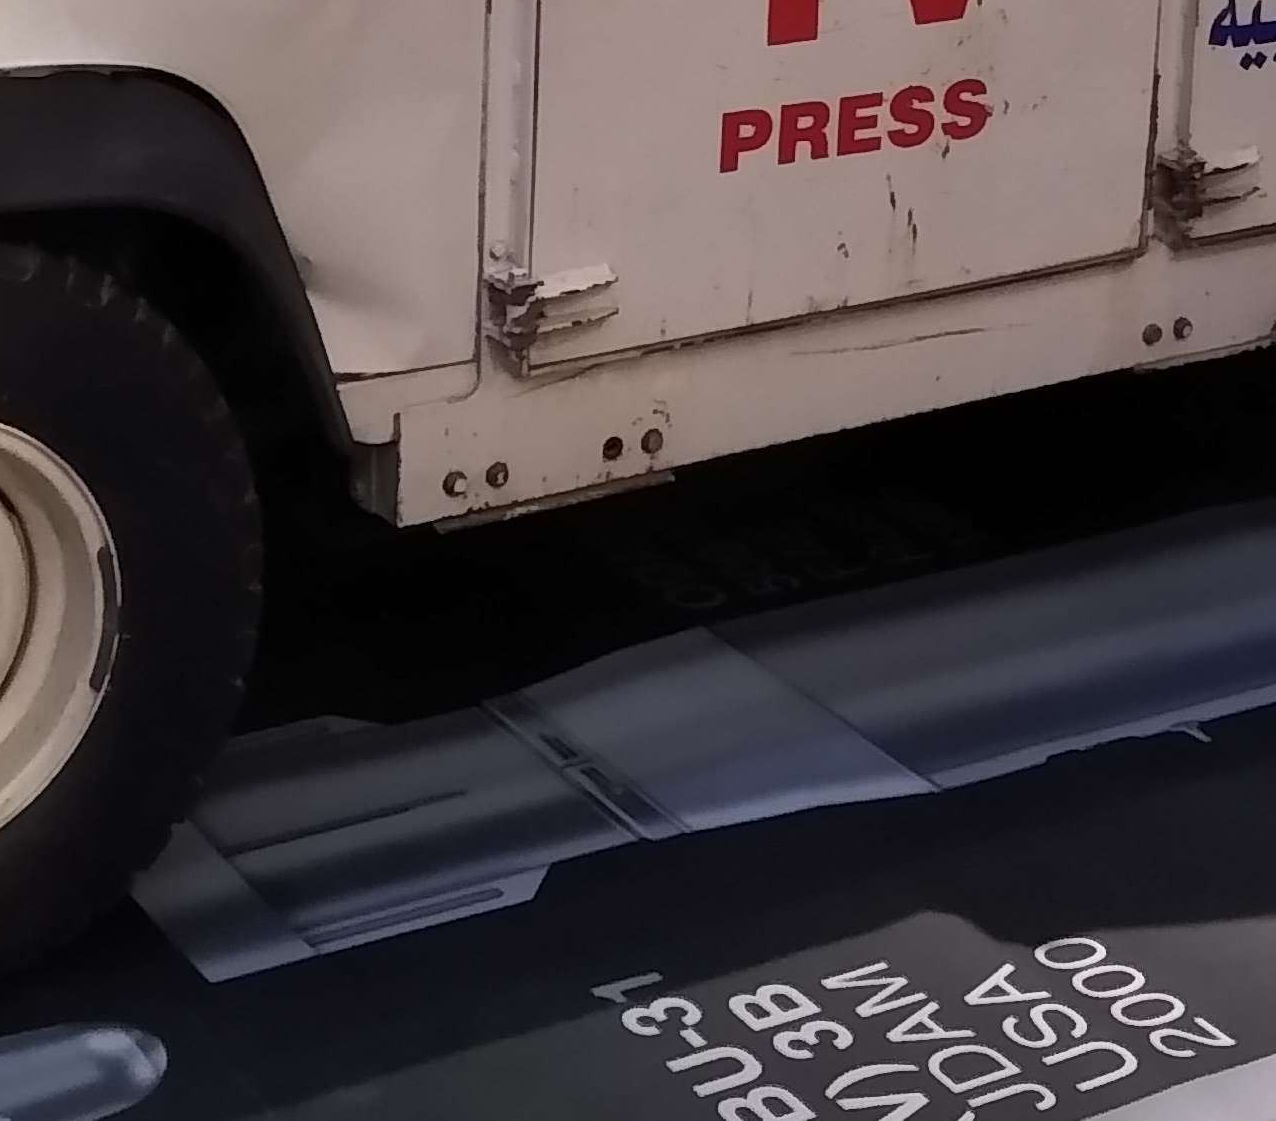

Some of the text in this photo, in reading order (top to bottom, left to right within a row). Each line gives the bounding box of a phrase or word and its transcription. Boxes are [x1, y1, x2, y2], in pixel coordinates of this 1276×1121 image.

[719, 77, 992, 174] PRESS
[728, 983, 855, 1060] 3B
[820, 960, 1057, 1111] JDAM
[964, 962, 1137, 1091] USA
[1034, 937, 1237, 1059] 2000
